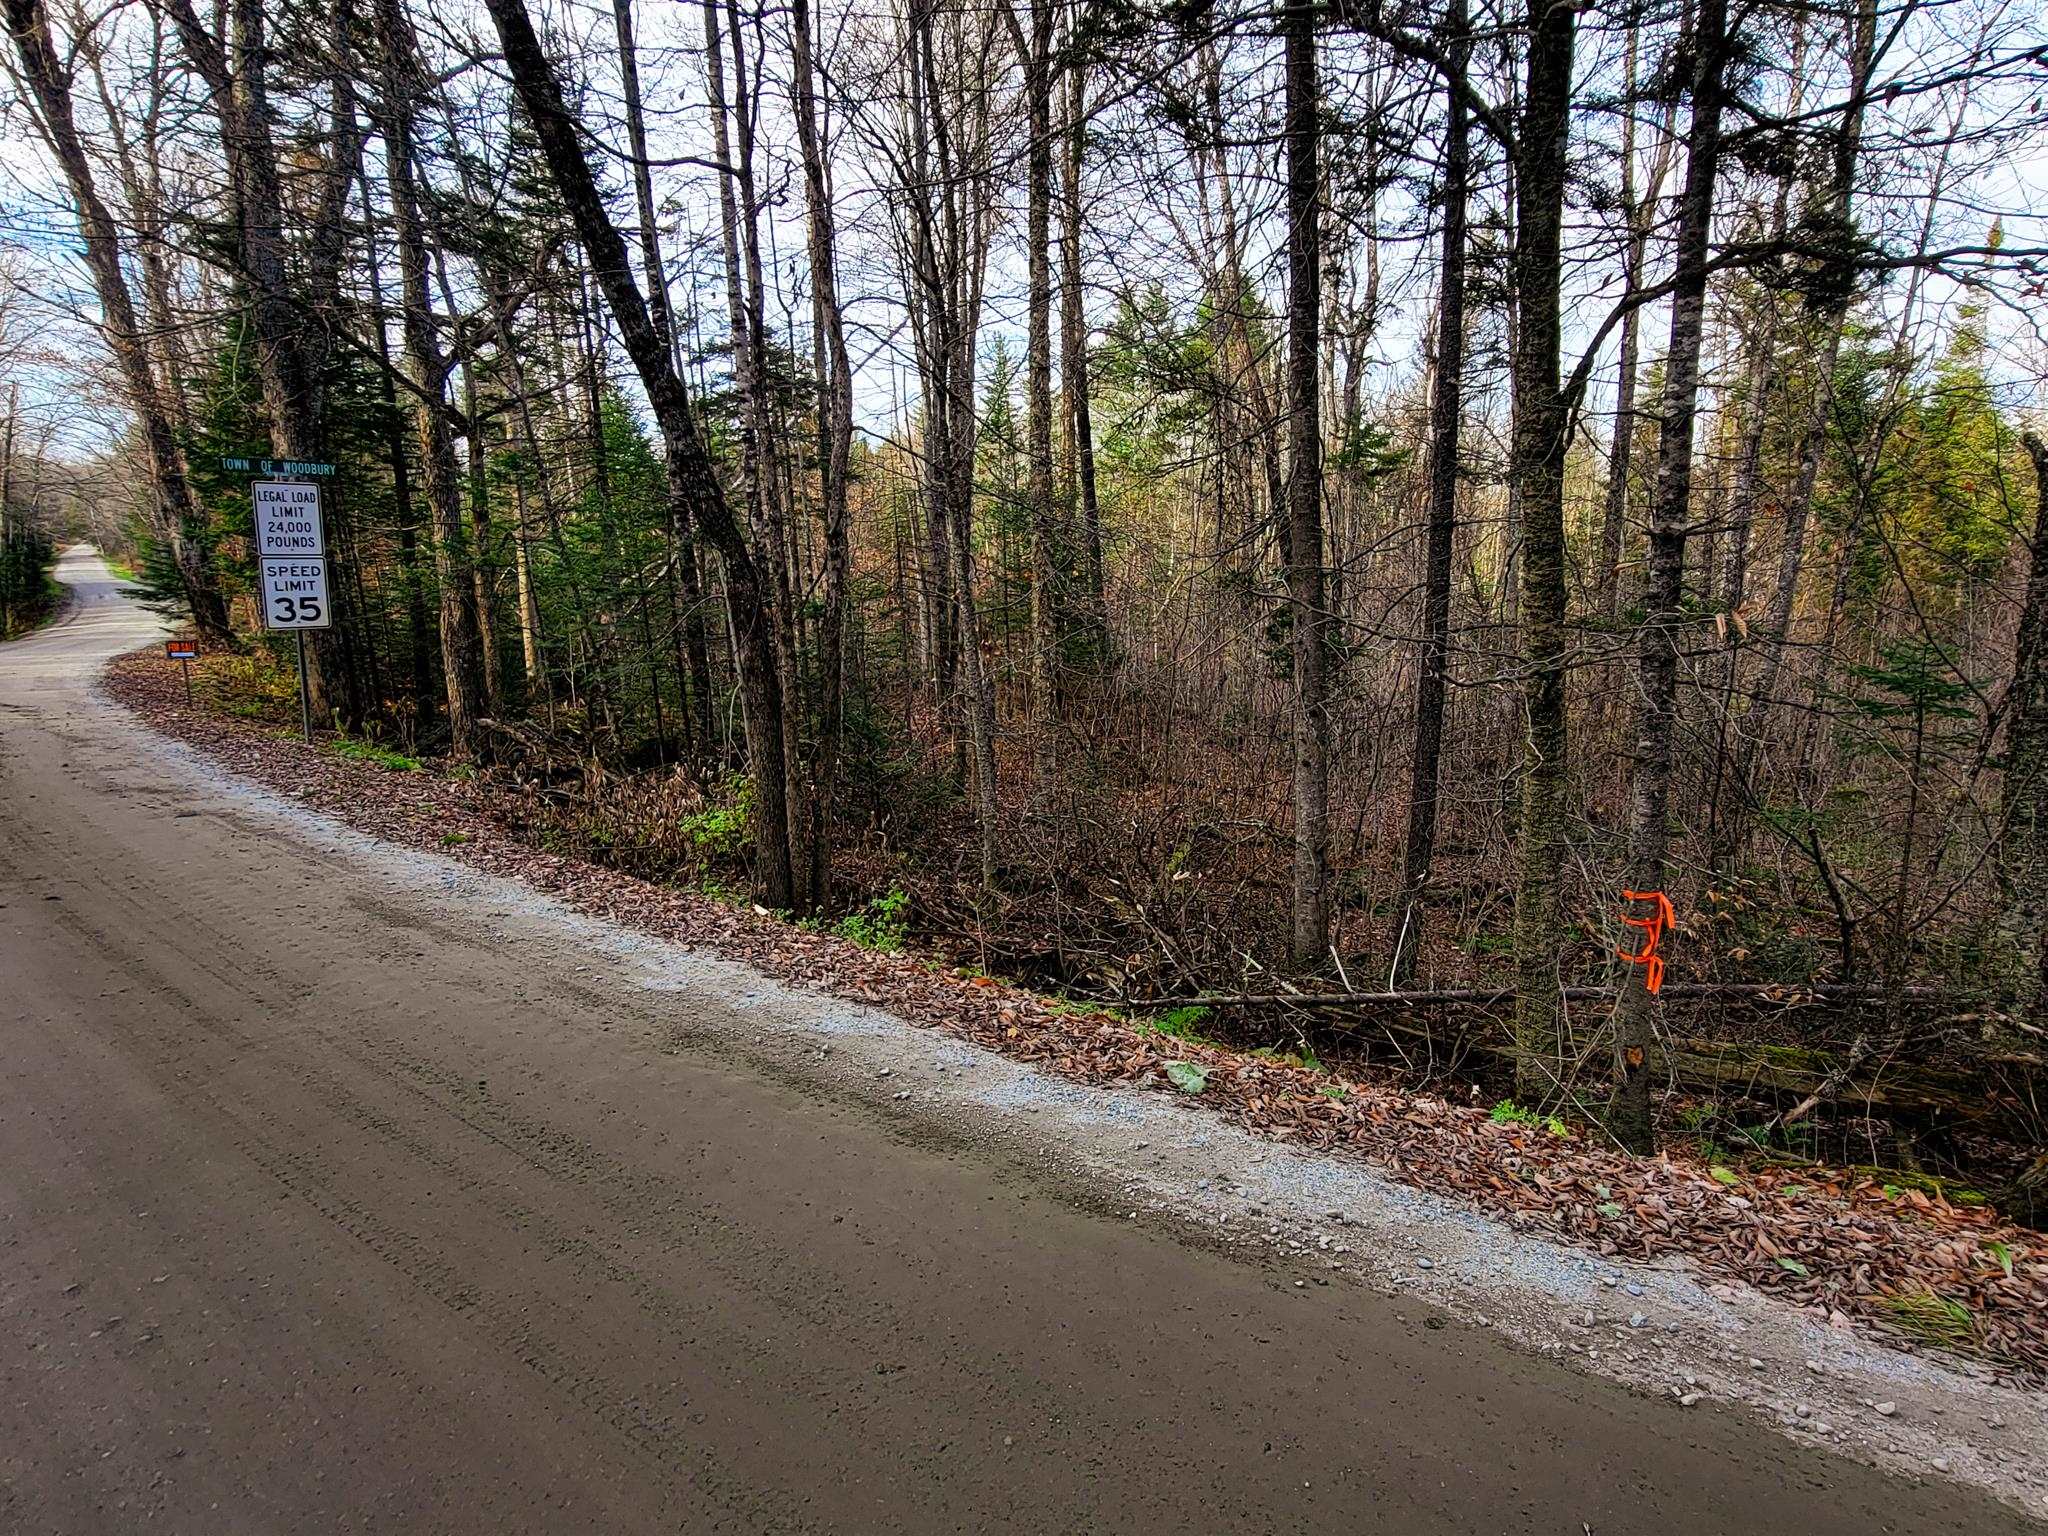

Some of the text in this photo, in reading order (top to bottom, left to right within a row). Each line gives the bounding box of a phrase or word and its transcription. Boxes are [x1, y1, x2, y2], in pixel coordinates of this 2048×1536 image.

[222, 458, 336, 475] TOWN OF WOODBURY
[257, 490, 316, 503] LEGAL LOAD
[272, 506, 304, 518] LIMIT
[268, 521, 312, 534] 24,000
[267, 536, 315, 548] POUNDS
[267, 565, 321, 577] SPEED
[274, 580, 316, 592] LIMIT
[274, 596, 321, 622] 35
[168, 642, 180, 652] FOR
